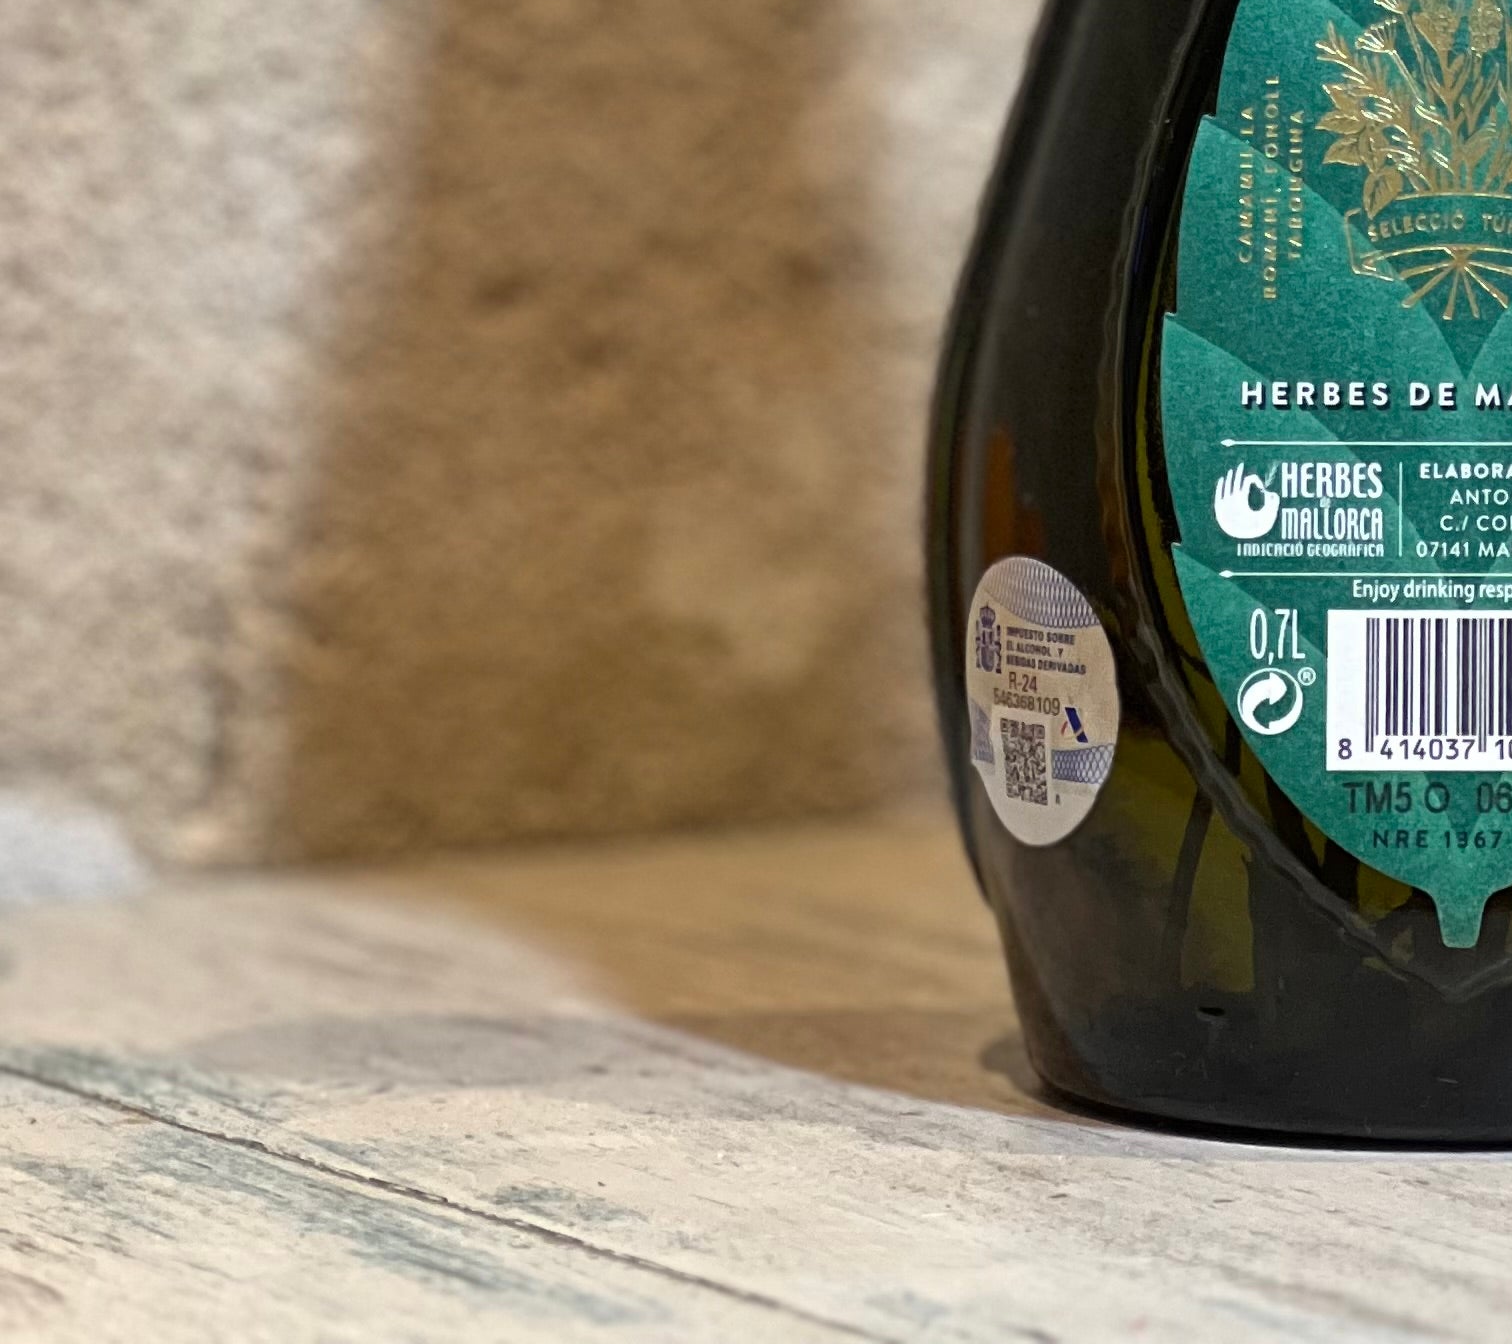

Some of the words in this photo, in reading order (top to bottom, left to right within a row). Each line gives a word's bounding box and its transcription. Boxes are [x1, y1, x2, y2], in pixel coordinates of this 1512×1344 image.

[1288, 111, 1304, 260] TARONGINA
[1241, 382, 1391, 407] HERBES
[1409, 382, 1457, 407] DE
[1281, 462, 1383, 499] HERBES
[1281, 507, 1383, 540] MALLORCA
[1439, 515, 1469, 532] C./
[1236, 542, 1304, 557] INDICACIÓ
[1415, 541, 1470, 558] 07141
[1353, 580, 1399, 602] Enjoy
[1403, 580, 1475, 602] drinking
[1250, 608, 1306, 665] 0,7L
[1017, 642, 1051, 657] ALCOHOL
[1038, 659, 1087, 675] DERIVADAS
[1008, 672, 1038, 693] R-24
[1338, 738, 1352, 760] 8
[1380, 738, 1476, 760] 414037
[1373, 829, 1429, 849] NRE
